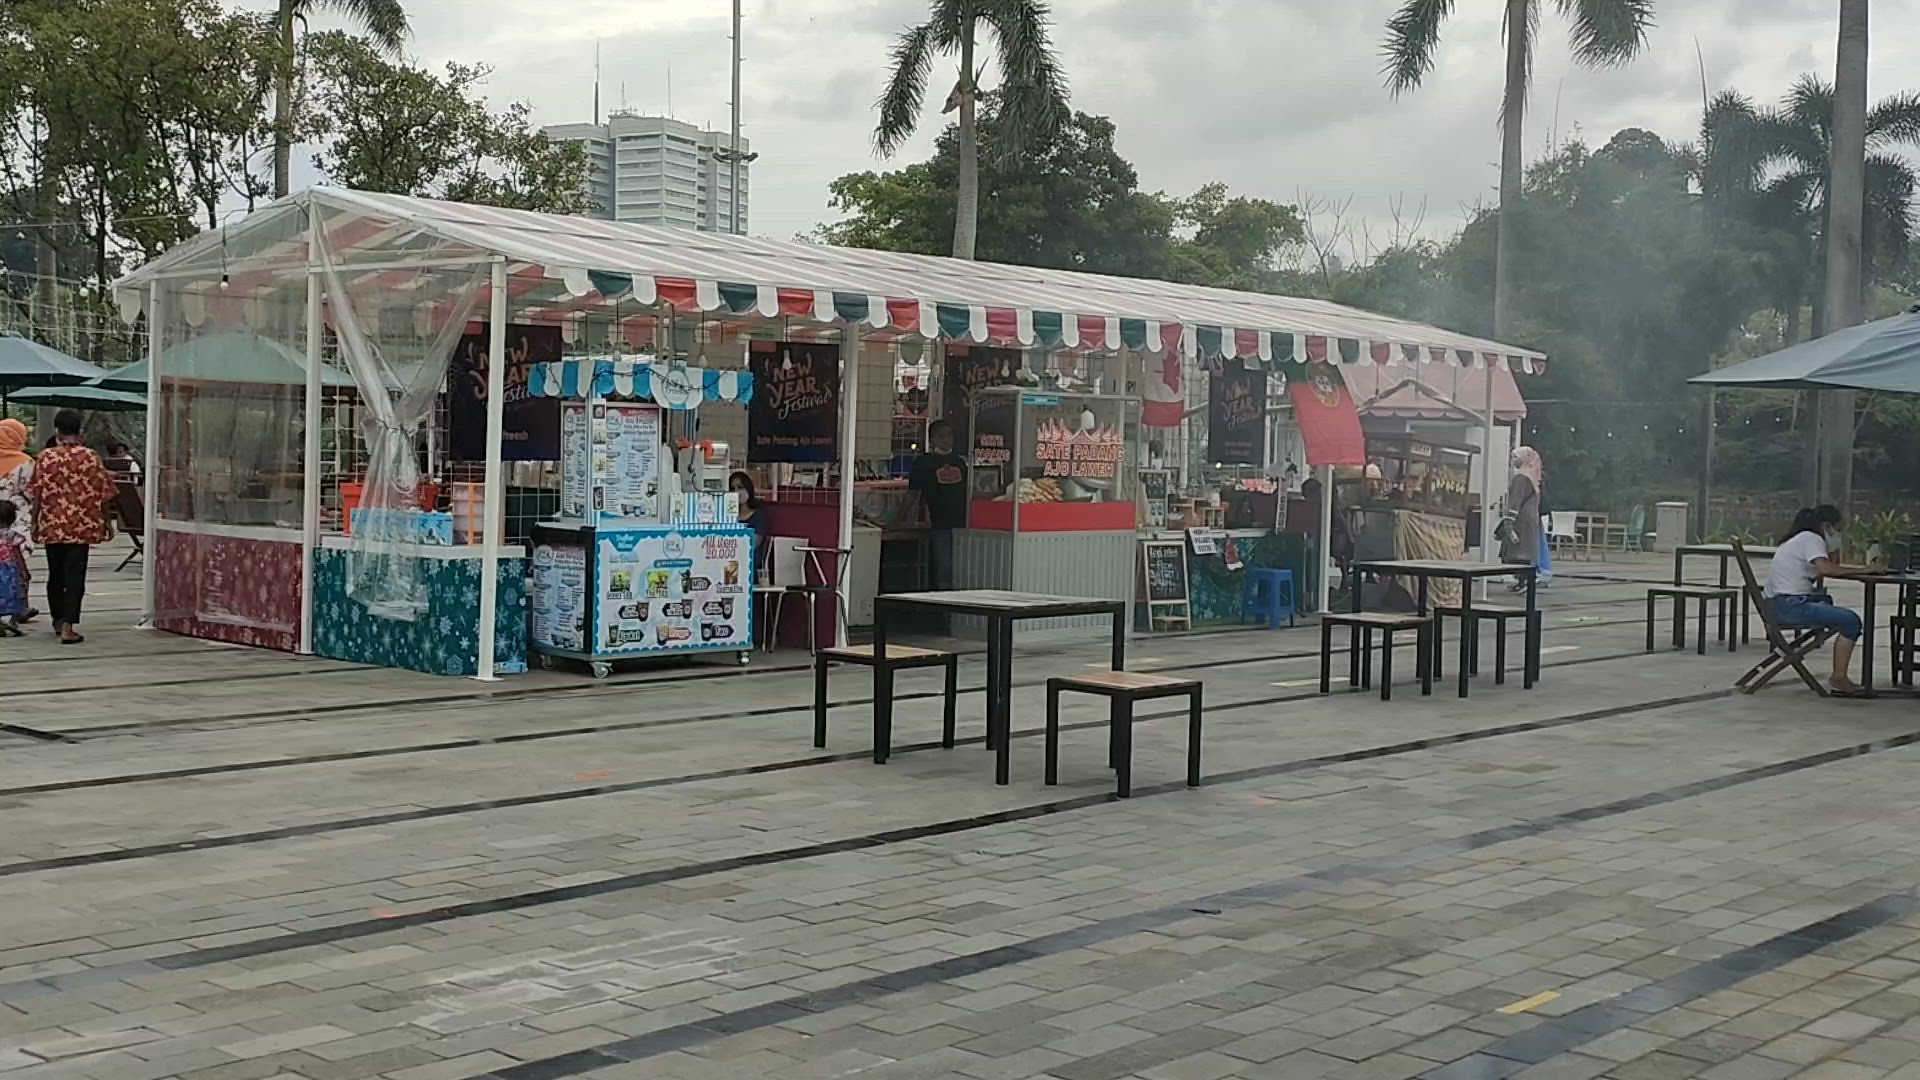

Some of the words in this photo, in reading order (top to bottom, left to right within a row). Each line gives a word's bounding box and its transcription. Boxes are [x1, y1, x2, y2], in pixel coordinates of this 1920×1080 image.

[766, 376, 819, 409] YEAR
[778, 384, 832, 420] Festival
[1036, 443, 1071, 460] SATE
[1073, 444, 1125, 462] PADANG
[1043, 461, 1069, 476] AJO
[1071, 461, 1113, 477] LAWEH
[701, 534, 716, 549] All
[717, 535, 738, 548] item
